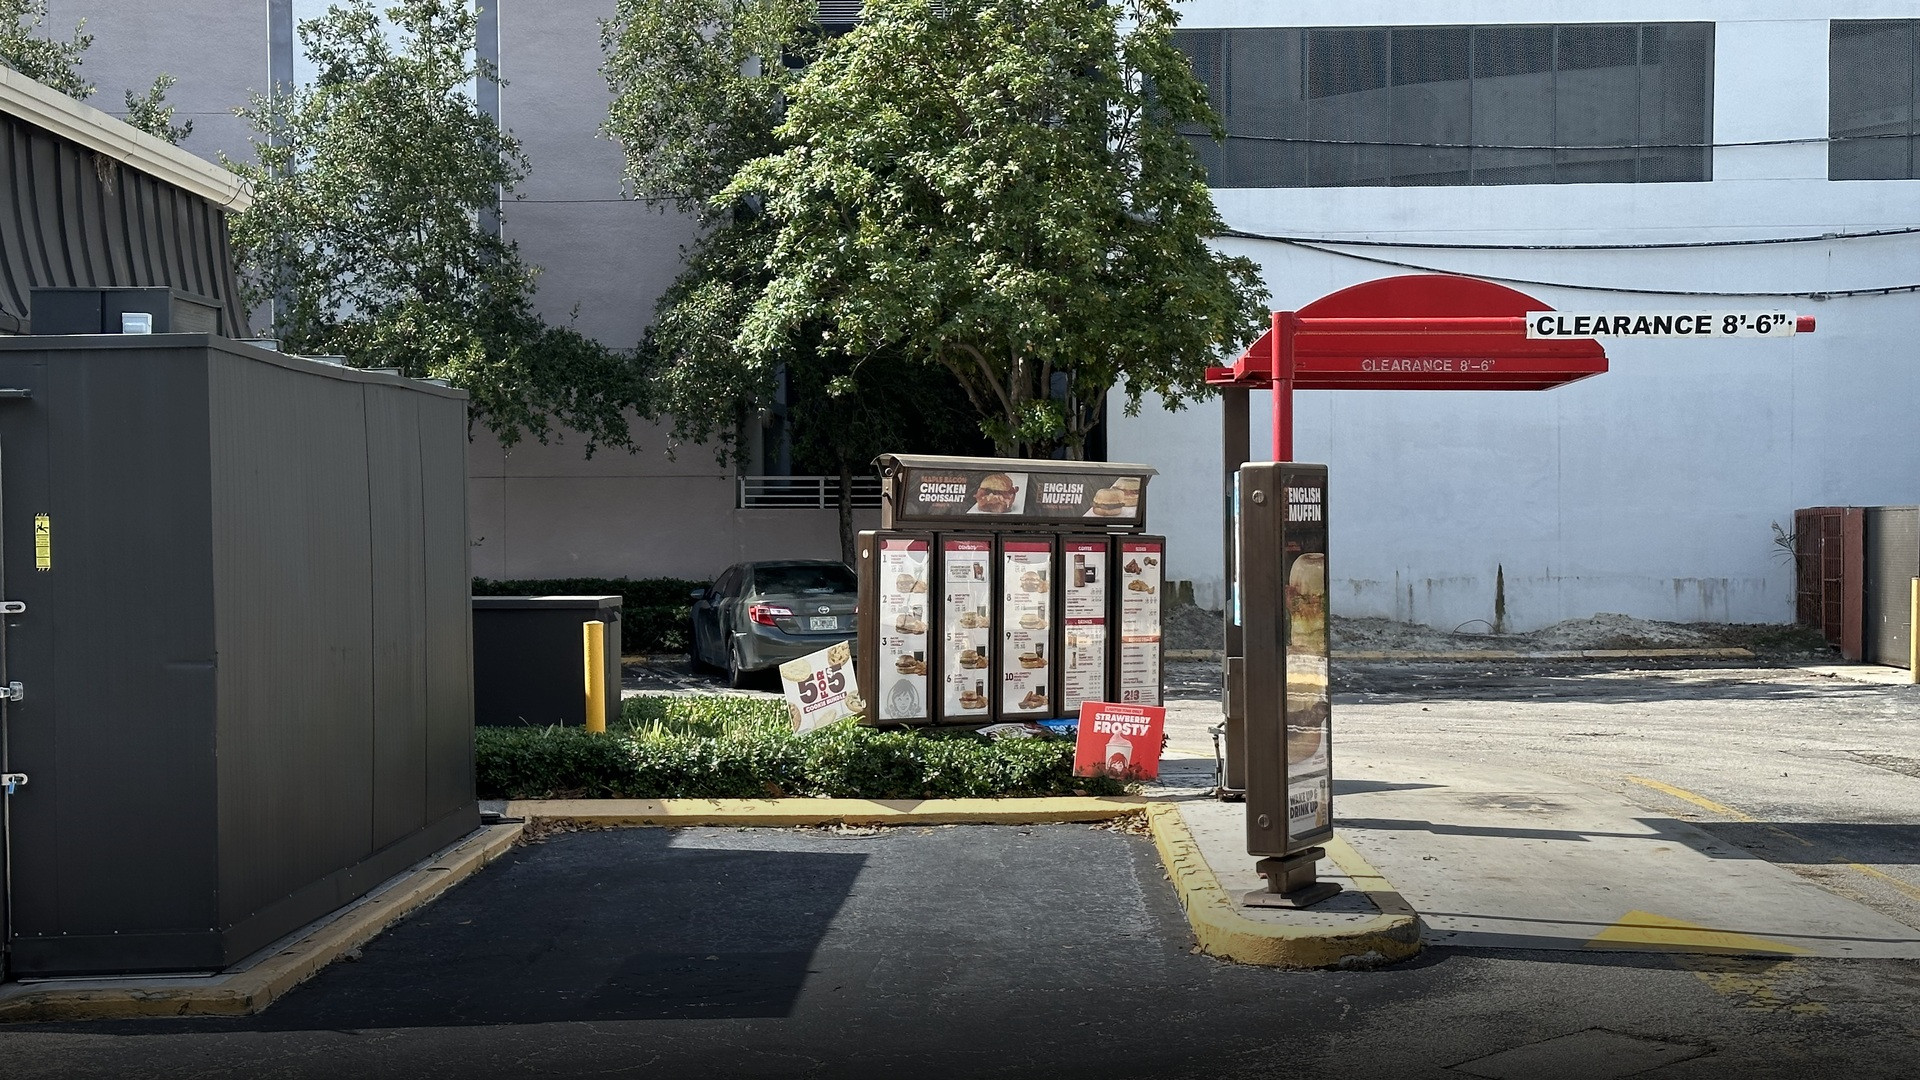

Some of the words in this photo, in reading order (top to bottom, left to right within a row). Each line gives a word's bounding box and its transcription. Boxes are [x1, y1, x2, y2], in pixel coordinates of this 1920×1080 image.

[1536, 316, 1713, 336] CLEARANCE
[1722, 314, 1786, 335] 8'-6"
[1362, 359, 1453, 372] CLEARANCE
[920, 483, 966, 494] CHICKEN
[1043, 483, 1084, 494] ENGLISH
[918, 494, 965, 503] CROISSANT
[1042, 493, 1083, 505] MUFFIN
[1289, 487, 1321, 503] ENGLISH
[1289, 504, 1321, 521] MUFFIN
[882, 595, 888, 604] 2
[946, 594, 952, 602] 4
[946, 632, 952, 640] 5
[1006, 632, 1012, 640] 9
[882, 638, 888, 646] 3
[946, 674, 952, 682] 6
[1005, 672, 1014, 682] 10
[797, 673, 818, 704] 5
[816, 670, 829, 699] FOR
[806, 700, 827, 713] COOKIE
[826, 692, 847, 705] BUNDLE
[1095, 713, 1151, 724] STRAWBERRY
[1093, 721, 1150, 736] FROSTY
[1290, 793, 1306, 806] WAKE
[1306, 790, 1313, 801] UP
[1290, 802, 1309, 819] DRINK
[1310, 801, 1318, 813] UP
